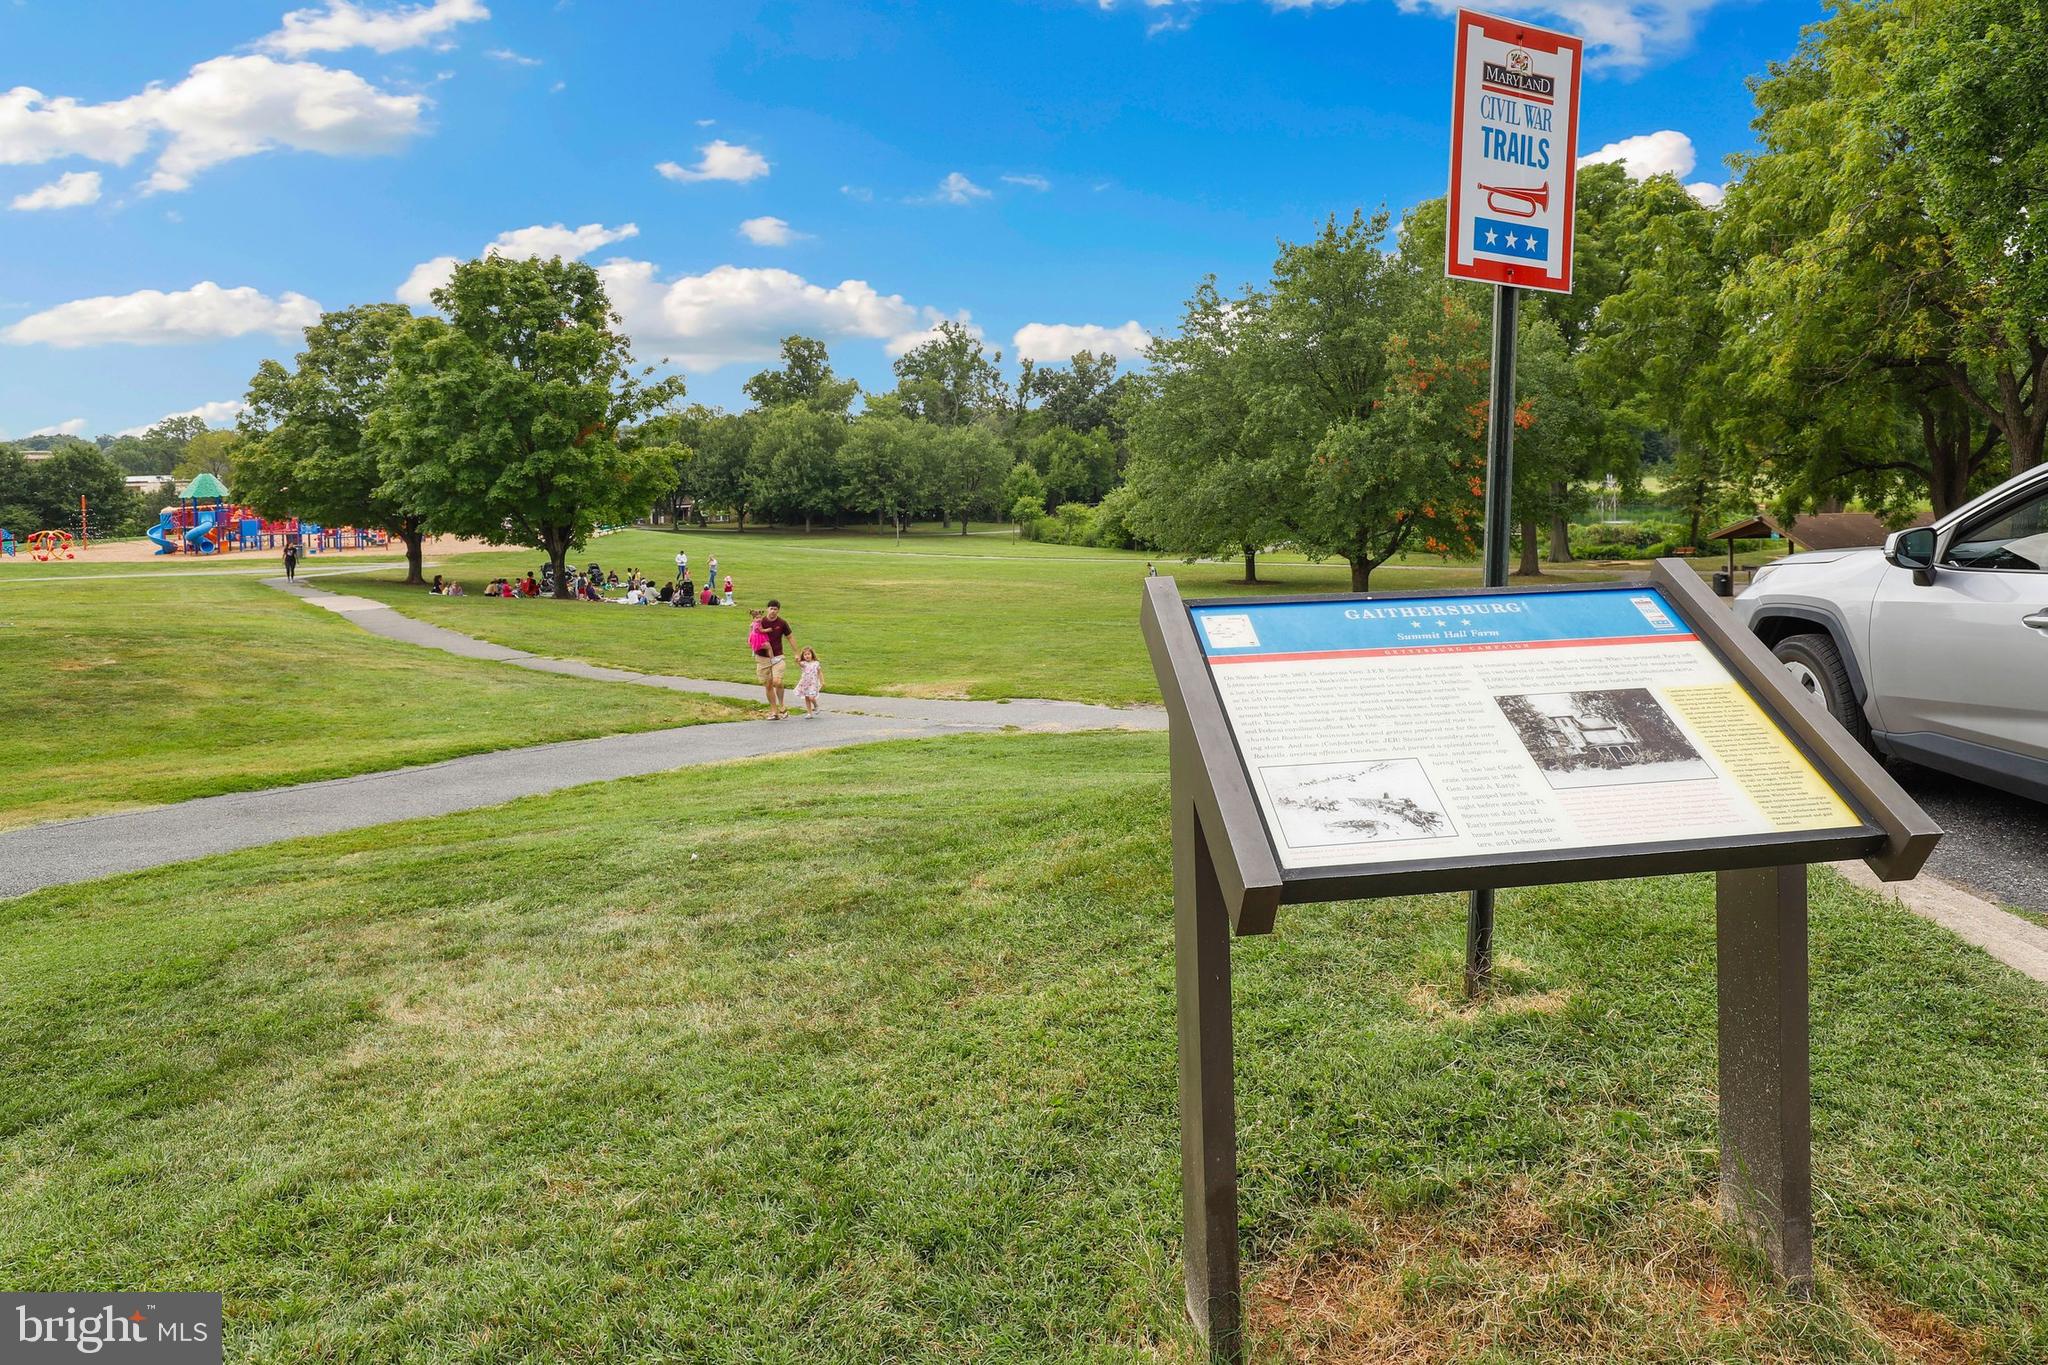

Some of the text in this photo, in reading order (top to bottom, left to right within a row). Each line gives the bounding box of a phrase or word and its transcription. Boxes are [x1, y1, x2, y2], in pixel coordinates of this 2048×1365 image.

[1485, 65, 1551, 94] MARYLAND
[1481, 95, 1552, 133] CIVIL WAR
[1481, 126, 1550, 170] TRAILS
[1344, 603, 1521, 620] GAITHERSBURG
[1397, 629, 1499, 641] Summit Hall Farm
[1384, 643, 1530, 656] GETTYSBURG CAMPAIGN
